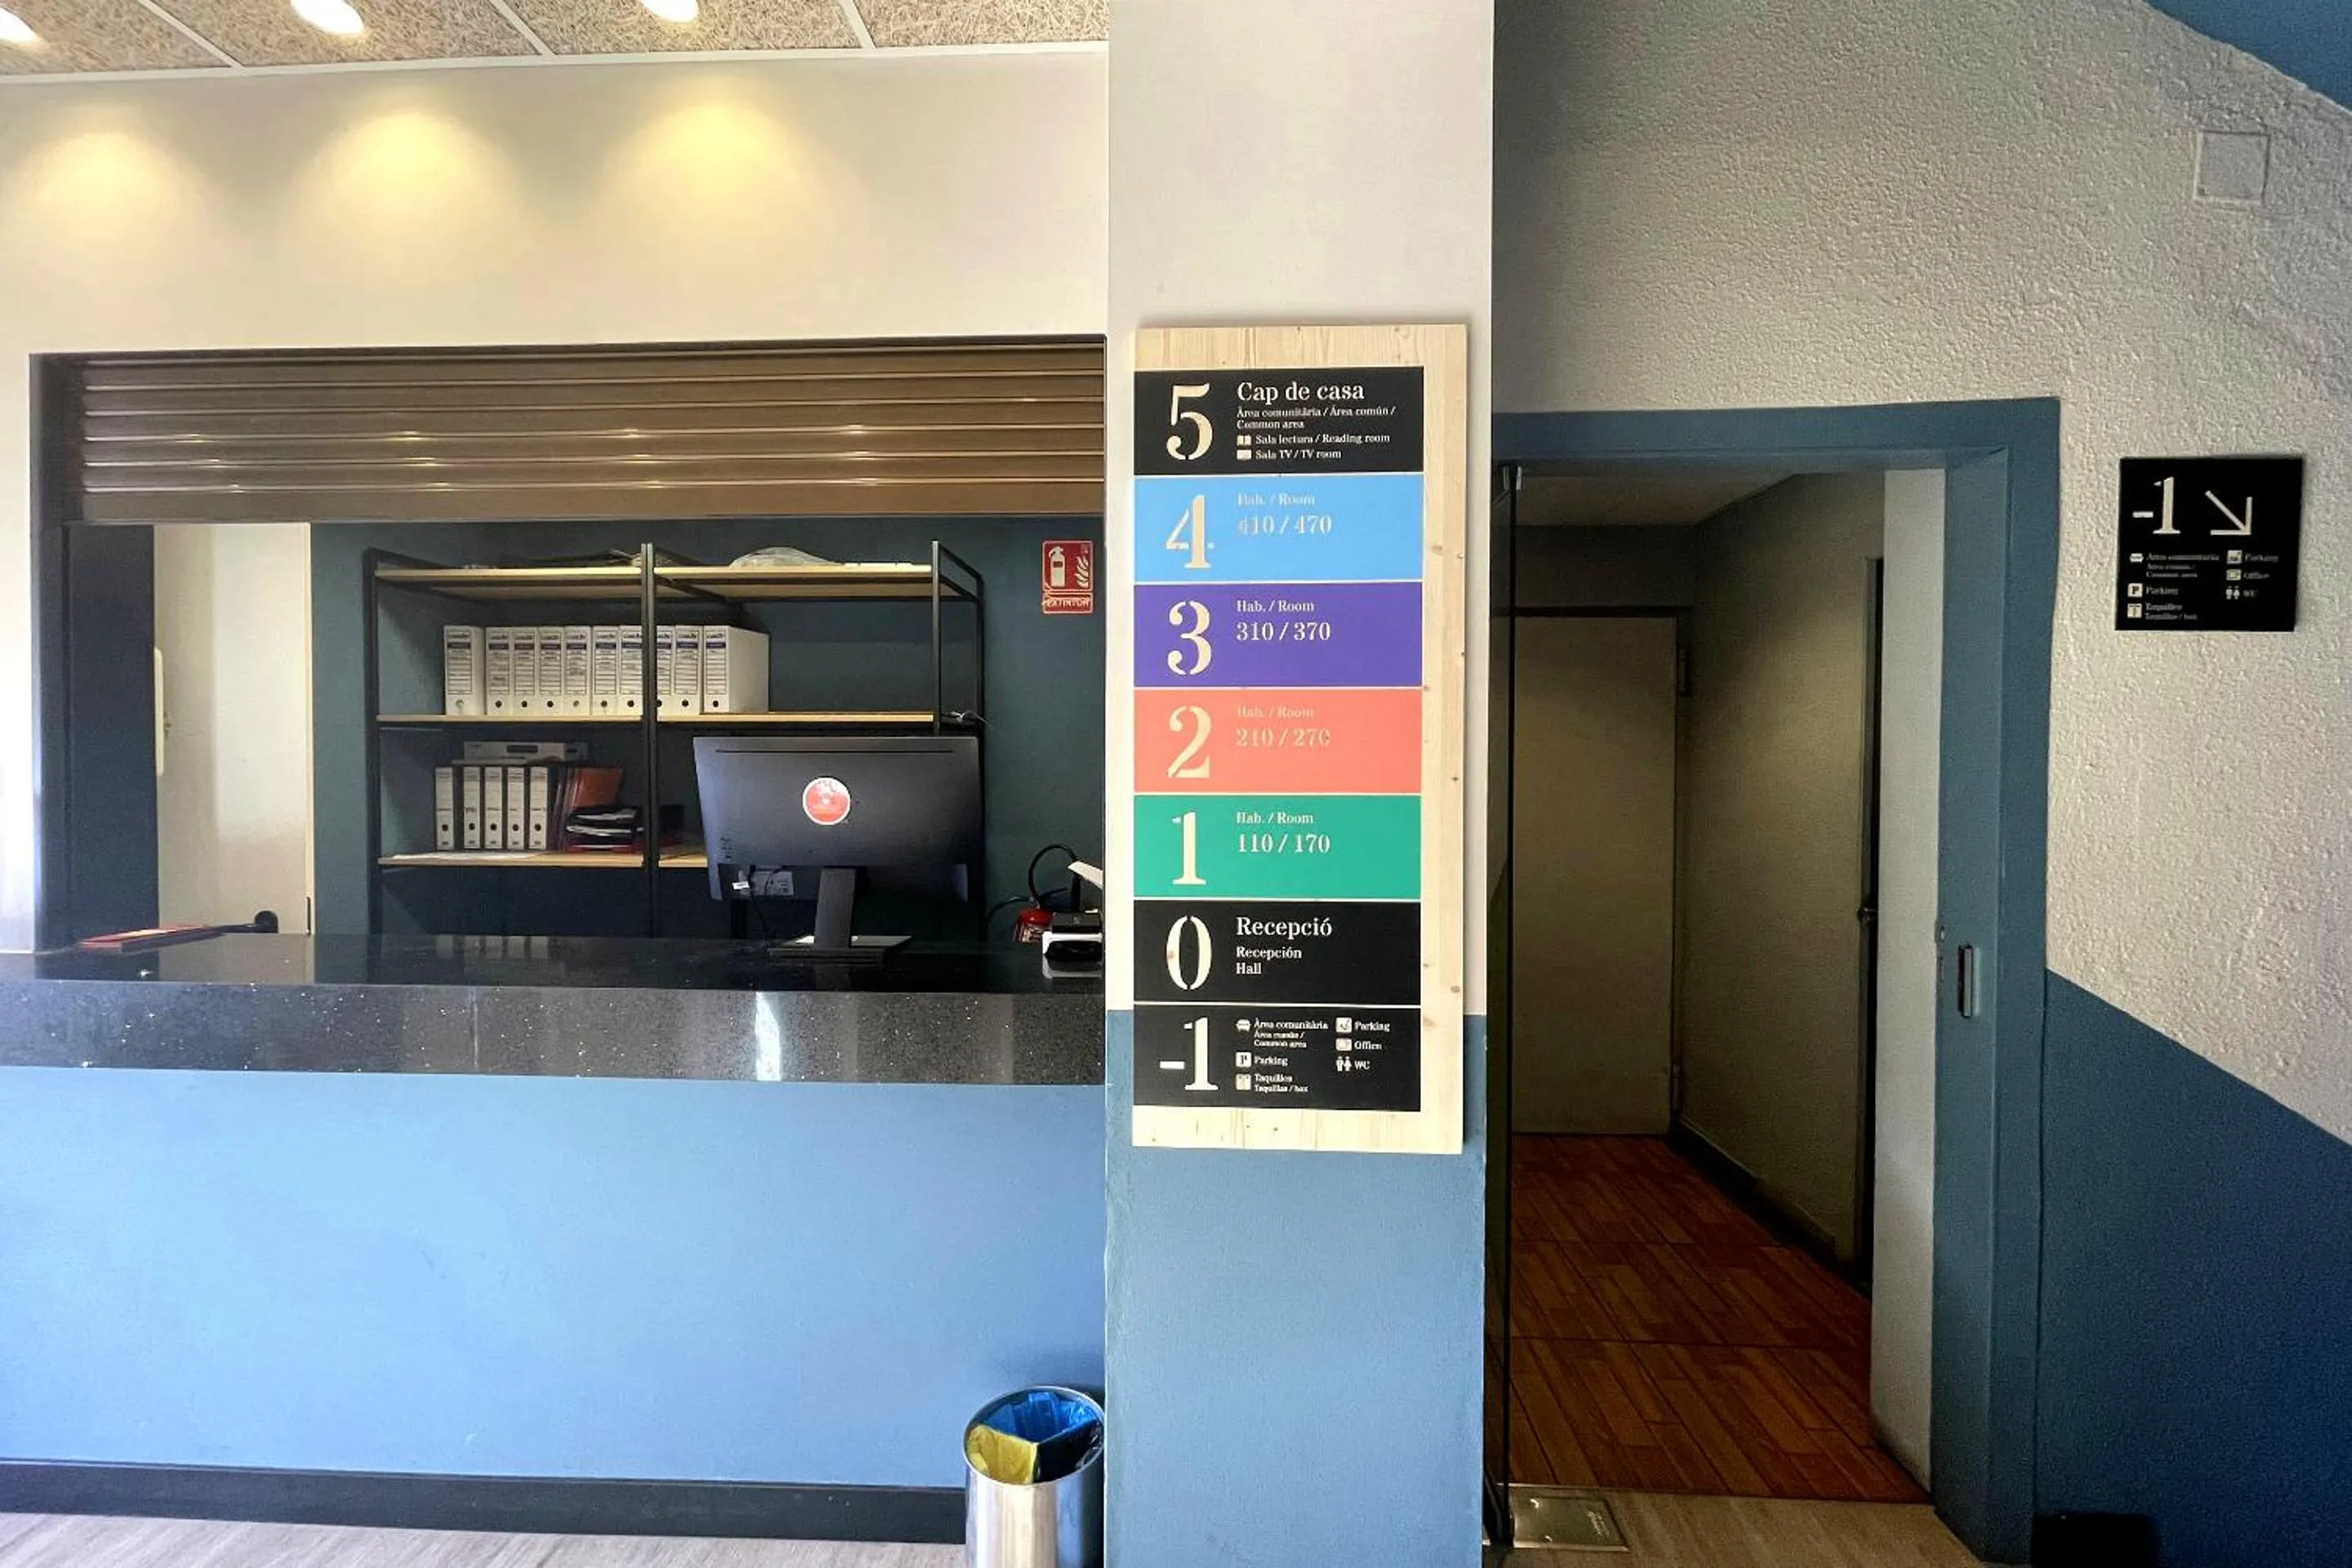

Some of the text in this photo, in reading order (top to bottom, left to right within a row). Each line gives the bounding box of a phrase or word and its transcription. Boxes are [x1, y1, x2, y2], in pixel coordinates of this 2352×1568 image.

[1237, 381, 1365, 405] Cap de casa
[1165, 382, 1214, 461] 5
[1236, 420, 1304, 430] Common area
[1255, 434, 1276, 444] Sala
[1279, 434, 1313, 444] lectura
[1322, 433, 1362, 445] Reading
[1365, 434, 1390, 443] room
[1255, 449, 1276, 460] Sala
[1280, 449, 1292, 459] TV
[1301, 449, 1314, 459] TV
[1316, 450, 1342, 459] room
[1278, 492, 1316, 506] Room
[2132, 476, 2181, 535] -1
[1165, 493, 1214, 569] 4
[1237, 514, 1274, 534] 410
[1294, 514, 1332, 534] 470
[1236, 599, 1267, 612] Hab.
[1278, 599, 1315, 612] Room
[1166, 600, 1213, 675] 3
[1236, 621, 1274, 641] 310
[1293, 621, 1331, 641] 370
[1277, 705, 1315, 718] Room
[1165, 705, 1213, 779] 2
[1236, 728, 1273, 746] 210
[1293, 727, 1330, 747] 270
[1236, 811, 1265, 824] Hab.
[1277, 811, 1313, 824] Room
[1171, 811, 1207, 885] 1
[1237, 833, 1273, 853] 110
[1294, 833, 1330, 853] 170
[1236, 916, 1333, 939] Recepció
[1165, 915, 1213, 991] 0
[1236, 946, 1303, 960] Recepción
[1236, 962, 1262, 975] Hall
[1354, 1021, 1391, 1032] Parking
[1159, 1017, 1219, 1091] -1
[1254, 1056, 1289, 1067] Parking
[1354, 1061, 1370, 1070] WC
